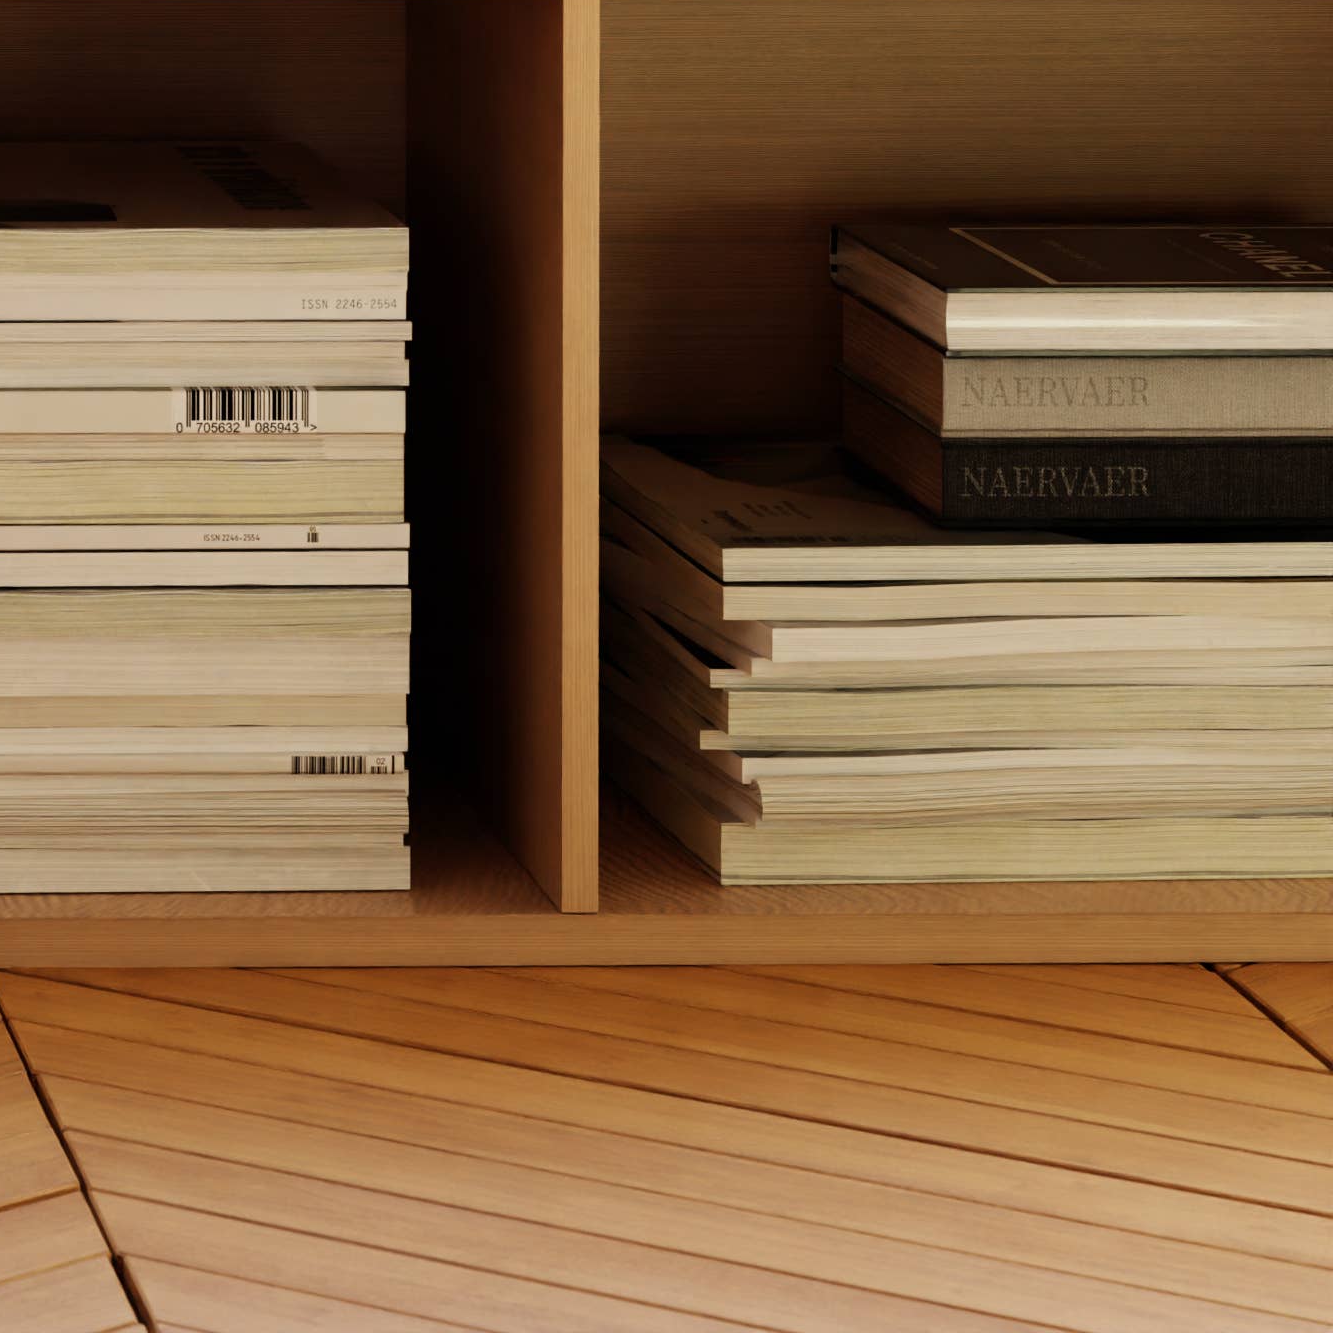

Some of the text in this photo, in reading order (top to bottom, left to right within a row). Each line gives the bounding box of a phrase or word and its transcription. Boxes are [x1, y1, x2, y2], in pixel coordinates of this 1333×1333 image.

[1197, 231, 1333, 278] CHANEL
[301, 299, 397, 309] ISSN 2246-2554
[962, 376, 1150, 407] NAERVAER
[175, 422, 299, 433] 0 705632 085943
[962, 466, 1150, 497] NAERVAER
[203, 534, 260, 542] ISSN 2246-2554
